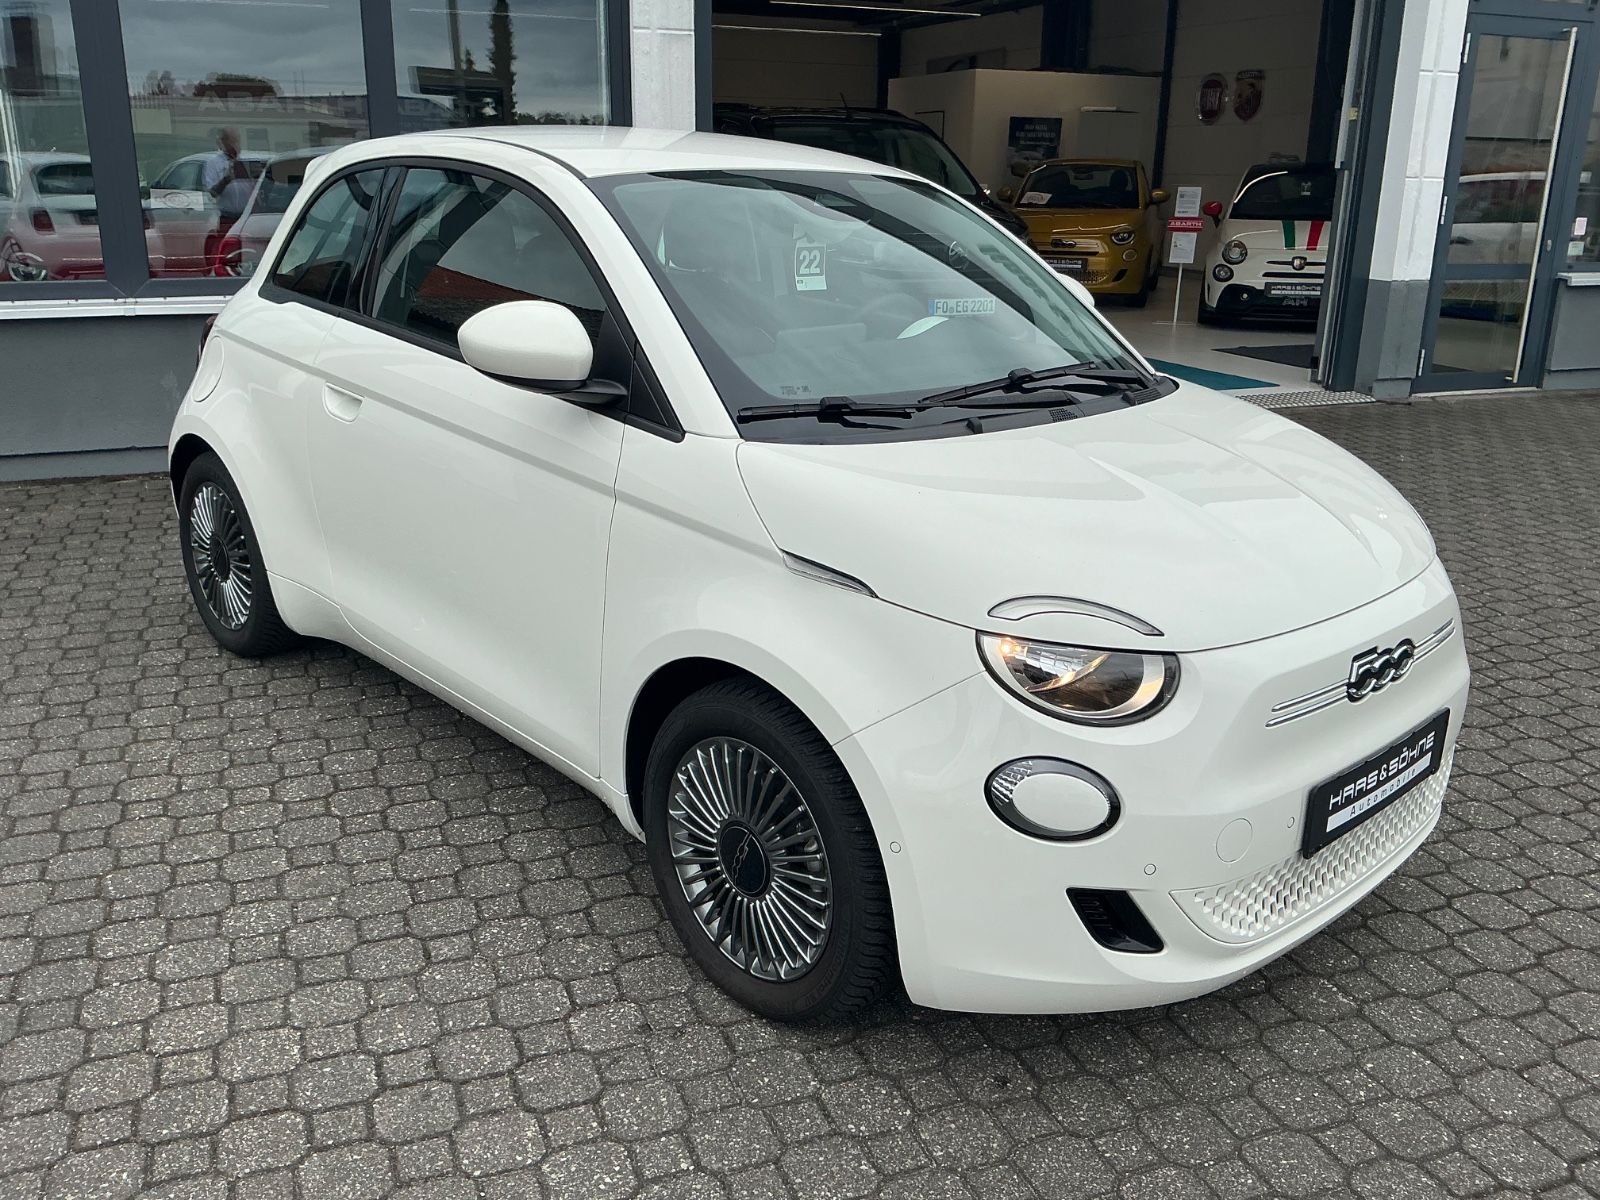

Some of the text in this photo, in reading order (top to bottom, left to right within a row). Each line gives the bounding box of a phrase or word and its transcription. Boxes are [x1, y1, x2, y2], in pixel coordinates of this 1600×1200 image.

[800, 250, 820, 274] 22
[936, 301, 948, 314] FO
[956, 300, 968, 313] EG
